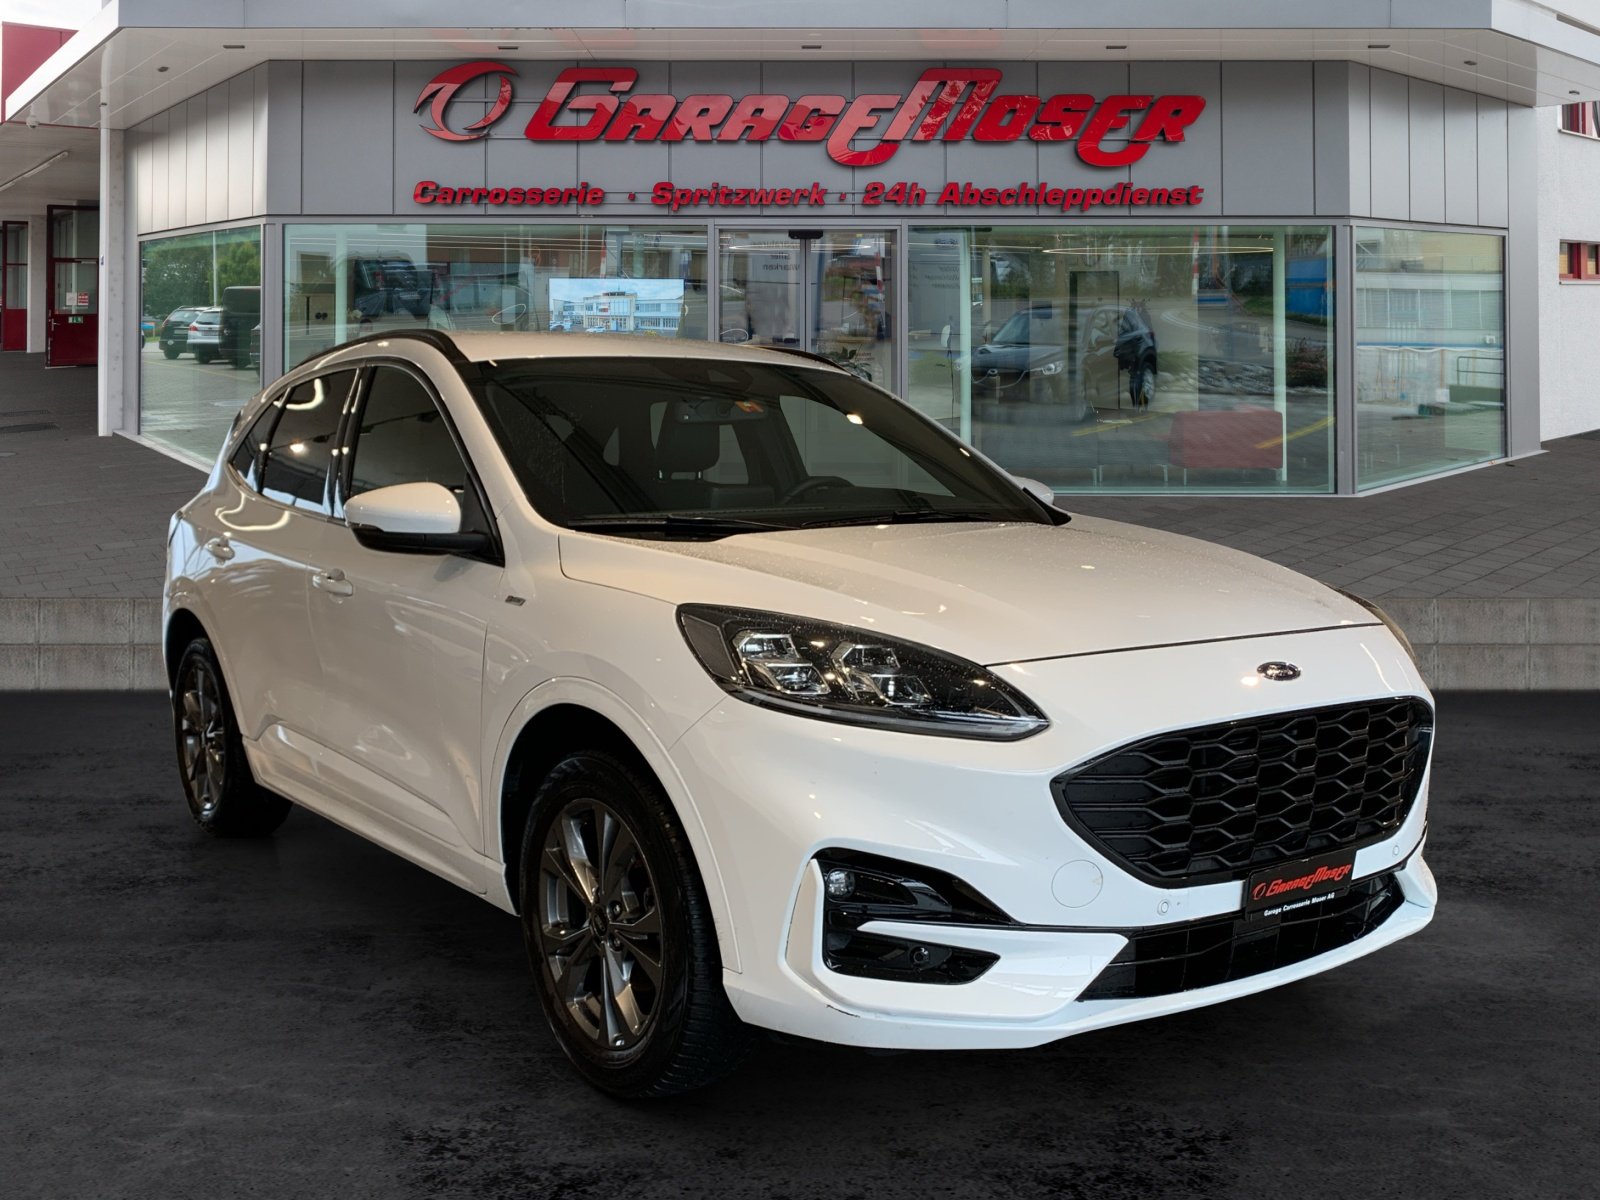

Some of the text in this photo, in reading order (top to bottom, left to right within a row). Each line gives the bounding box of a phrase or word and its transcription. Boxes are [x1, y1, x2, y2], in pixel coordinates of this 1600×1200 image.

[413, 180, 1205, 212] Carrosserie Spritzwerk 24h Abschleppdienst
